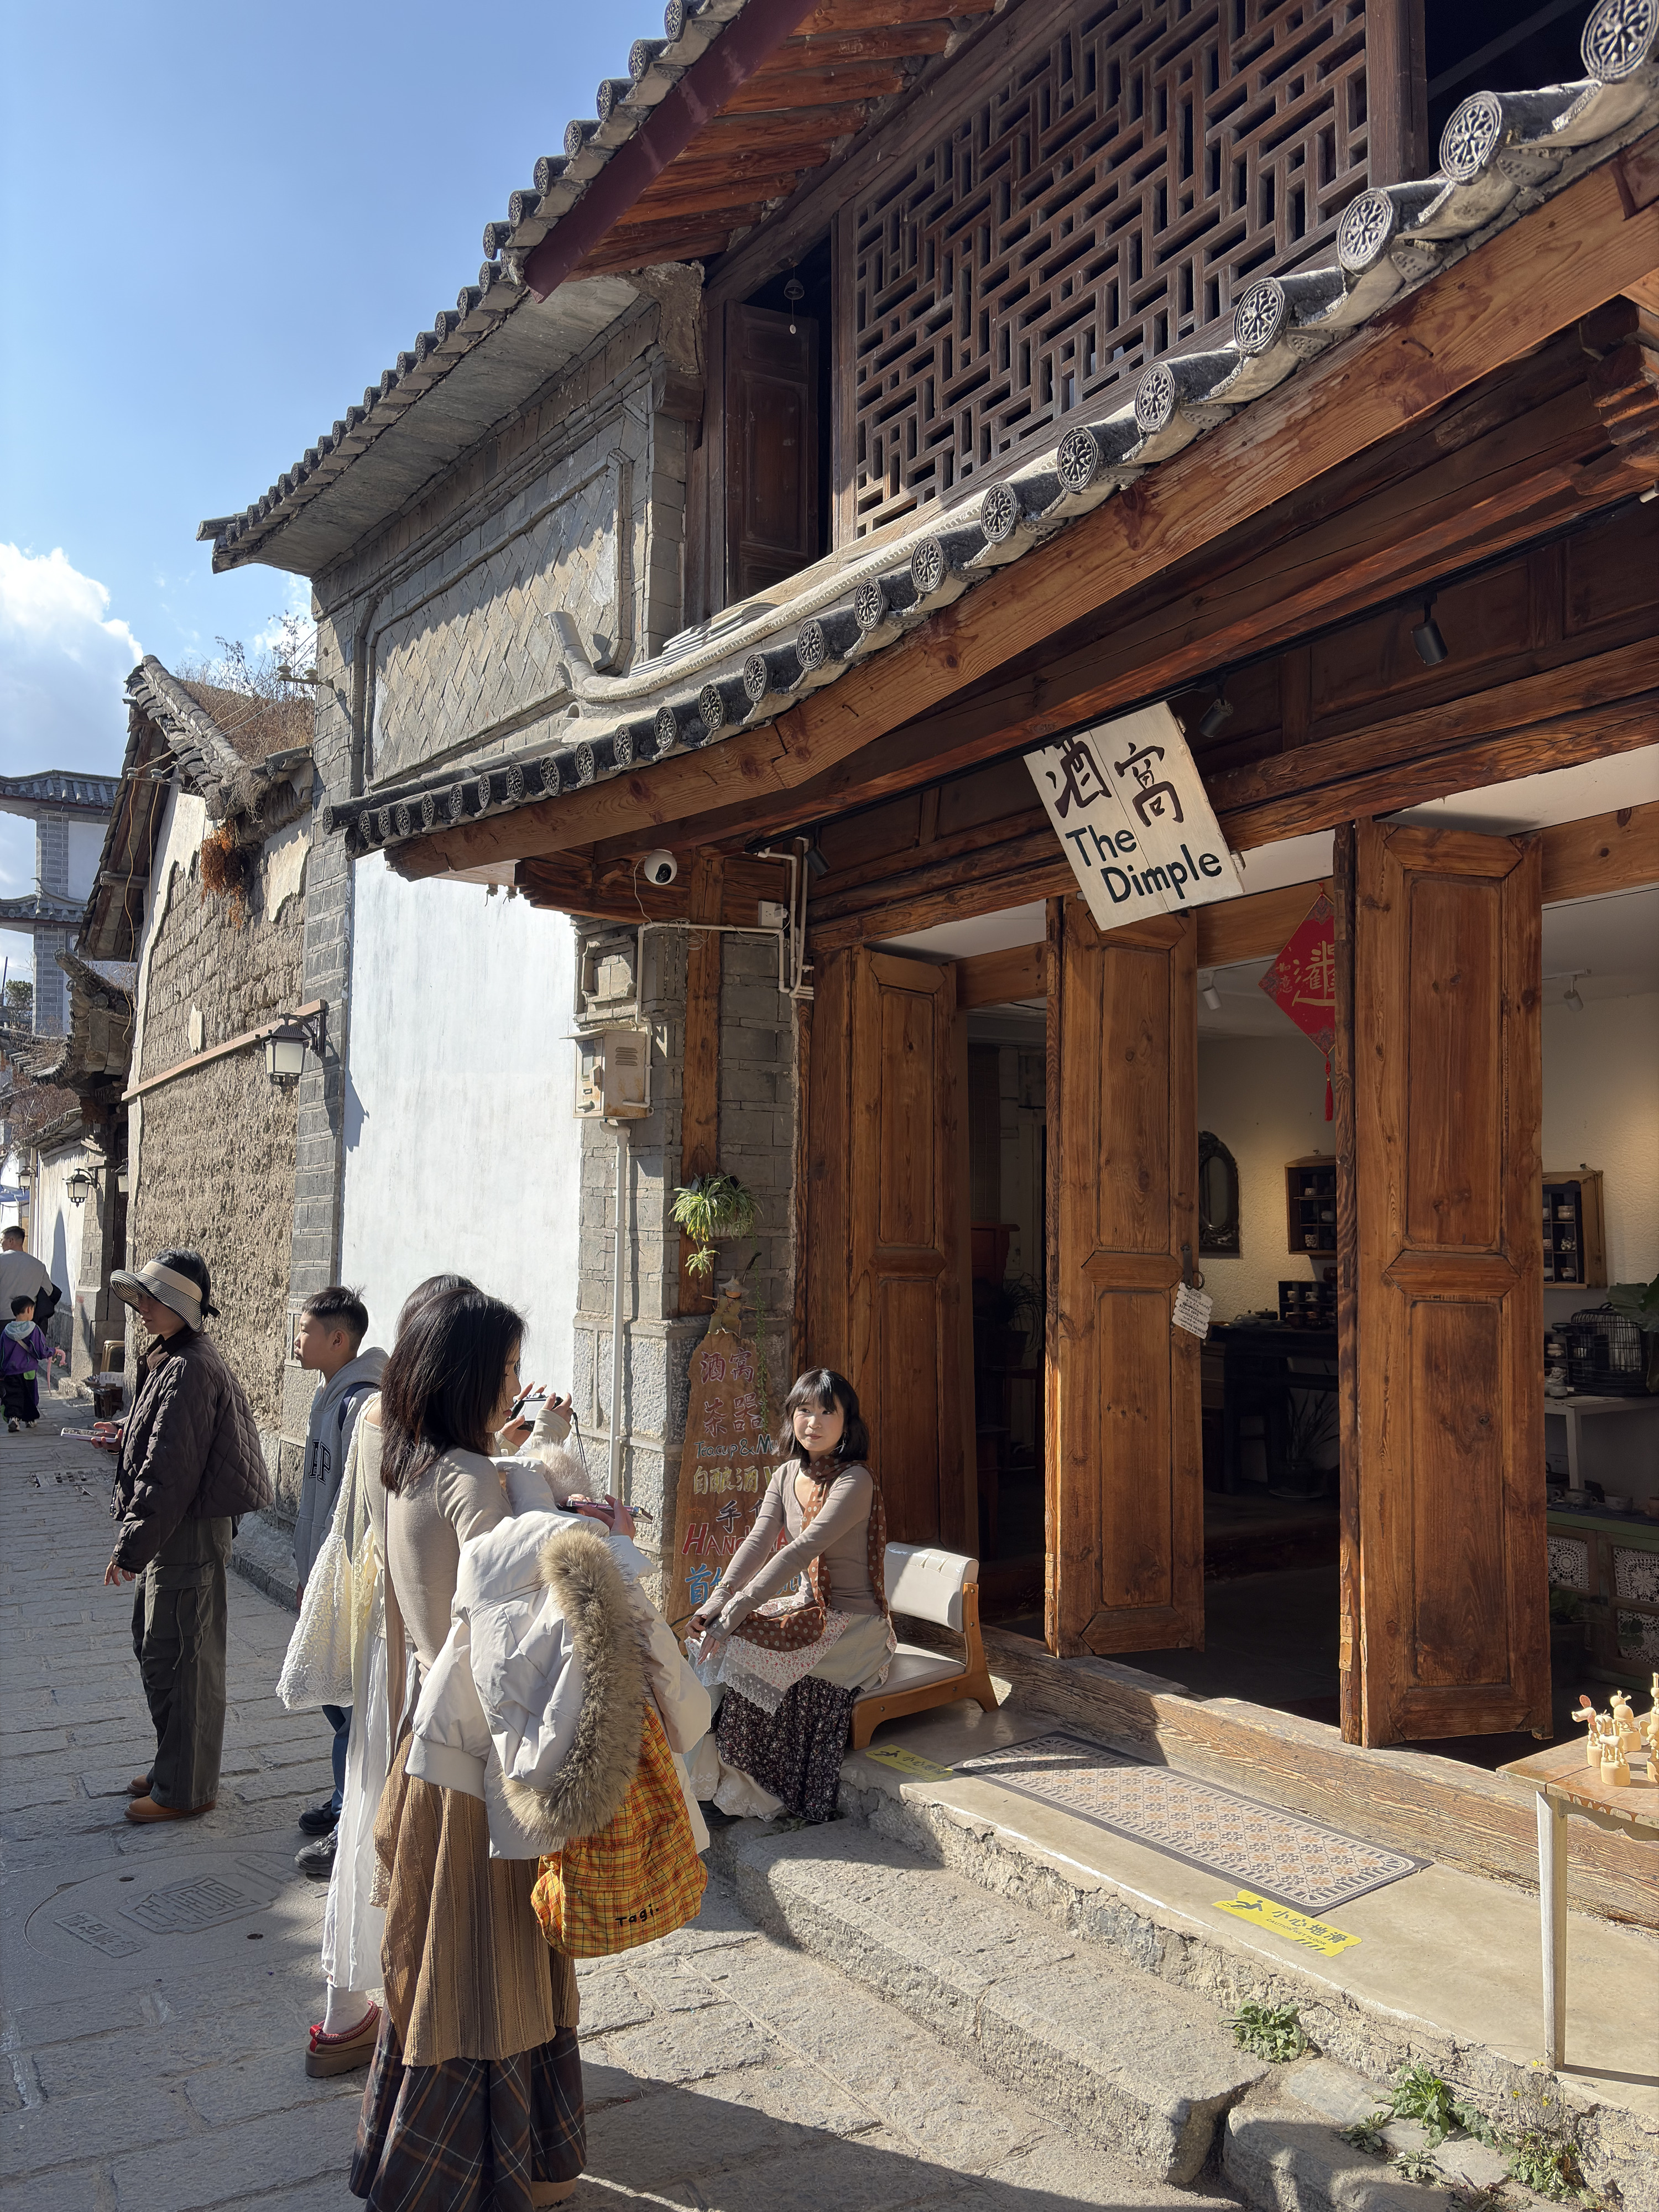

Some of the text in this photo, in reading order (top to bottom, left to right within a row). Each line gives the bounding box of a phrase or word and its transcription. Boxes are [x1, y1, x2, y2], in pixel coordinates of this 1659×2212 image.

[1065, 825, 1137, 867] The
[1100, 844, 1222, 903] Dimple
[756, 1434, 780, 1456] Mu
[1266, 1918, 1293, 1931] CAUTION
[1305, 1935, 1327, 1945] FLOOR
[1271, 1911, 1349, 1943] 小心地滑
